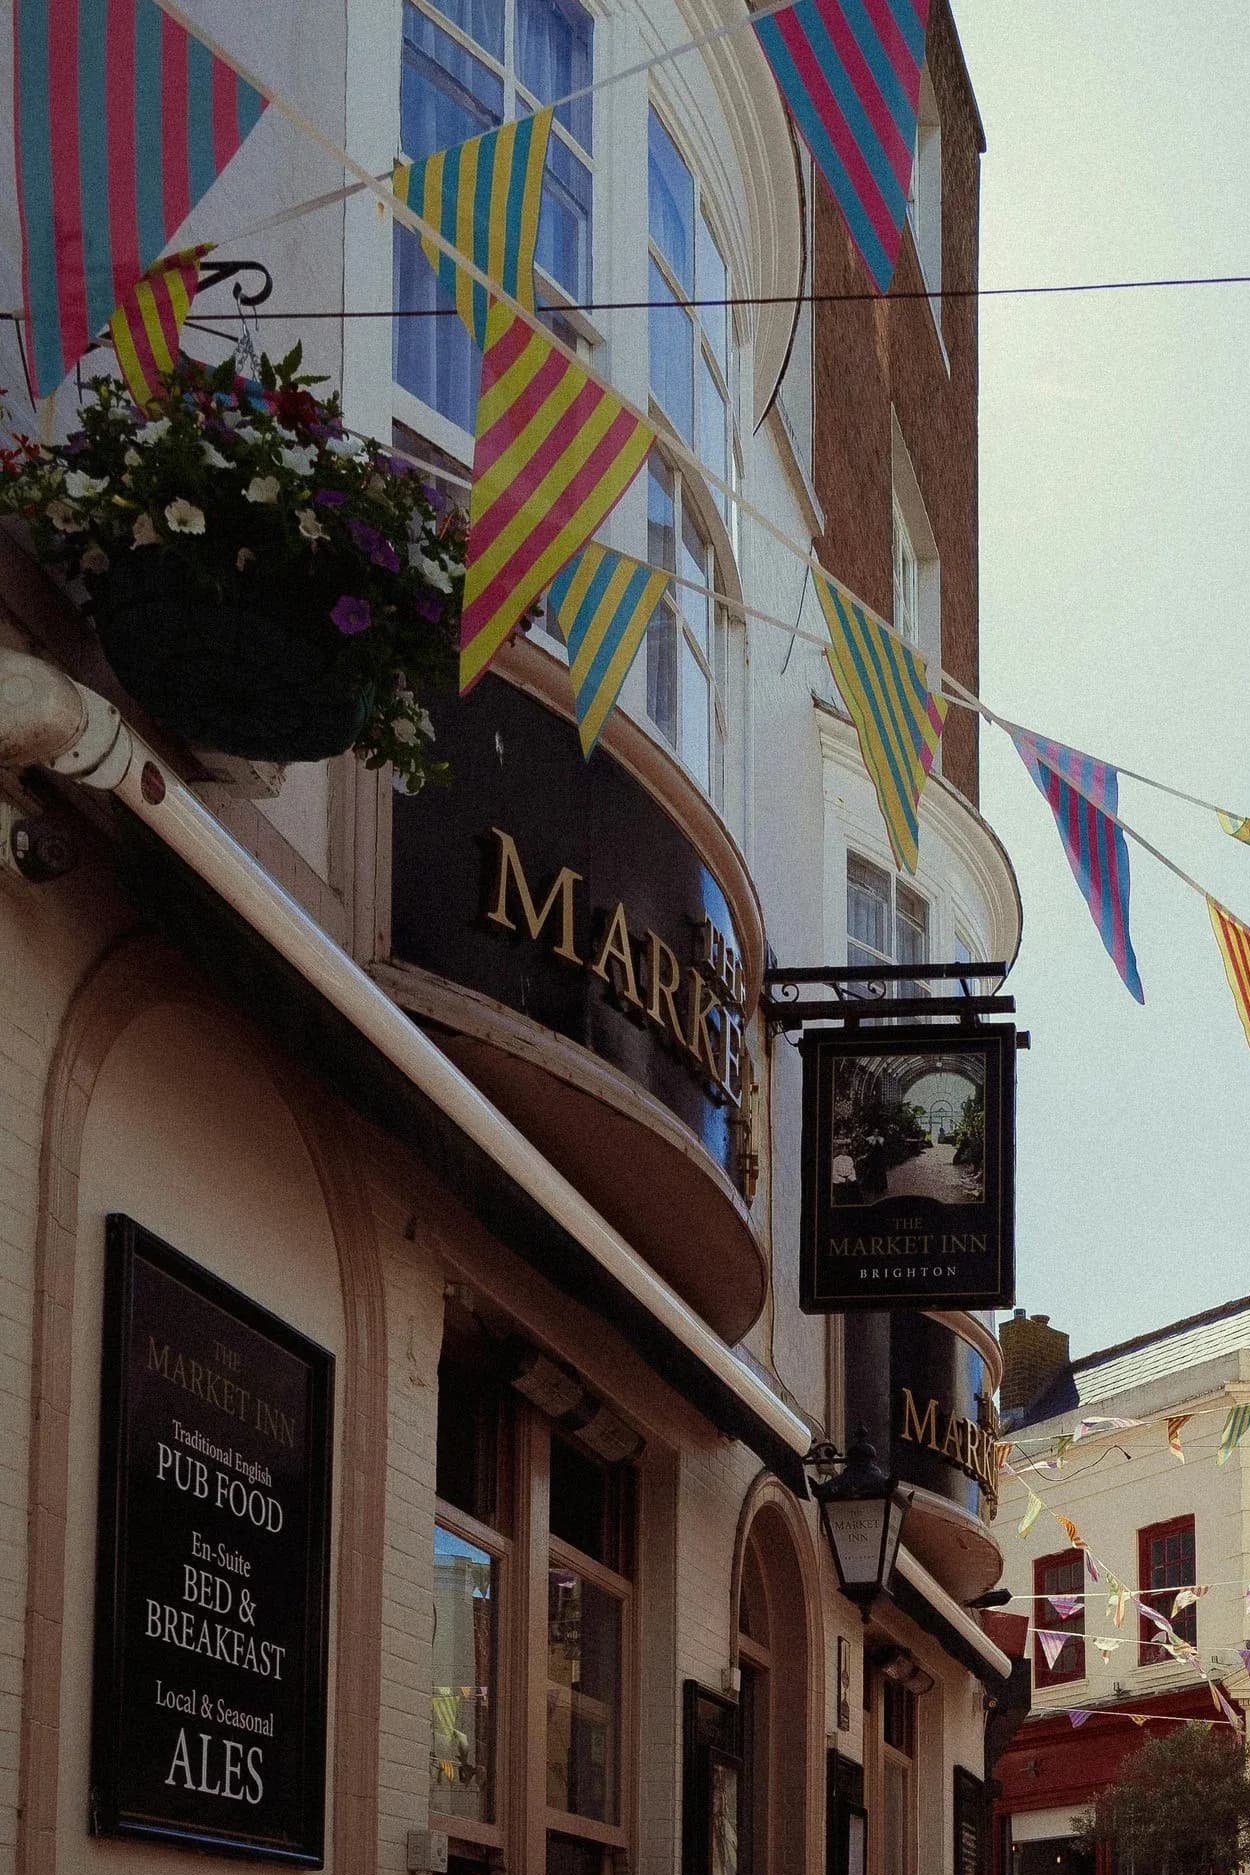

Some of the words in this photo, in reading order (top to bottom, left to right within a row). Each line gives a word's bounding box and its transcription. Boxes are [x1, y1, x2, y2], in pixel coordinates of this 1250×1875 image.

[487, 827, 742, 1108] MARKE
[828, 1234, 935, 1257] MARKET
[941, 1233, 990, 1254] INN
[895, 1217, 923, 1230] THE
[859, 1266, 957, 1280] BRIGHTON
[146, 1336, 250, 1422] MARKET
[255, 1398, 295, 1449] INN
[172, 1418, 232, 1468] Traditional
[235, 1453, 273, 1489] English
[901, 1387, 995, 1491] MARK
[156, 1442, 209, 1499] PUB
[214, 1471, 284, 1534] FOOD
[191, 1530, 252, 1578] En-Suite
[832, 1519, 879, 1531] MARKET
[847, 1533, 868, 1543] INN
[182, 1564, 232, 1615] BED
[239, 1588, 257, 1628] &
[144, 1599, 287, 1681] BREAKFAST
[156, 1680, 197, 1716] Local
[200, 1693, 213, 1721] &
[216, 1699, 275, 1738] Seasonal
[164, 1727, 264, 1805] ALES
